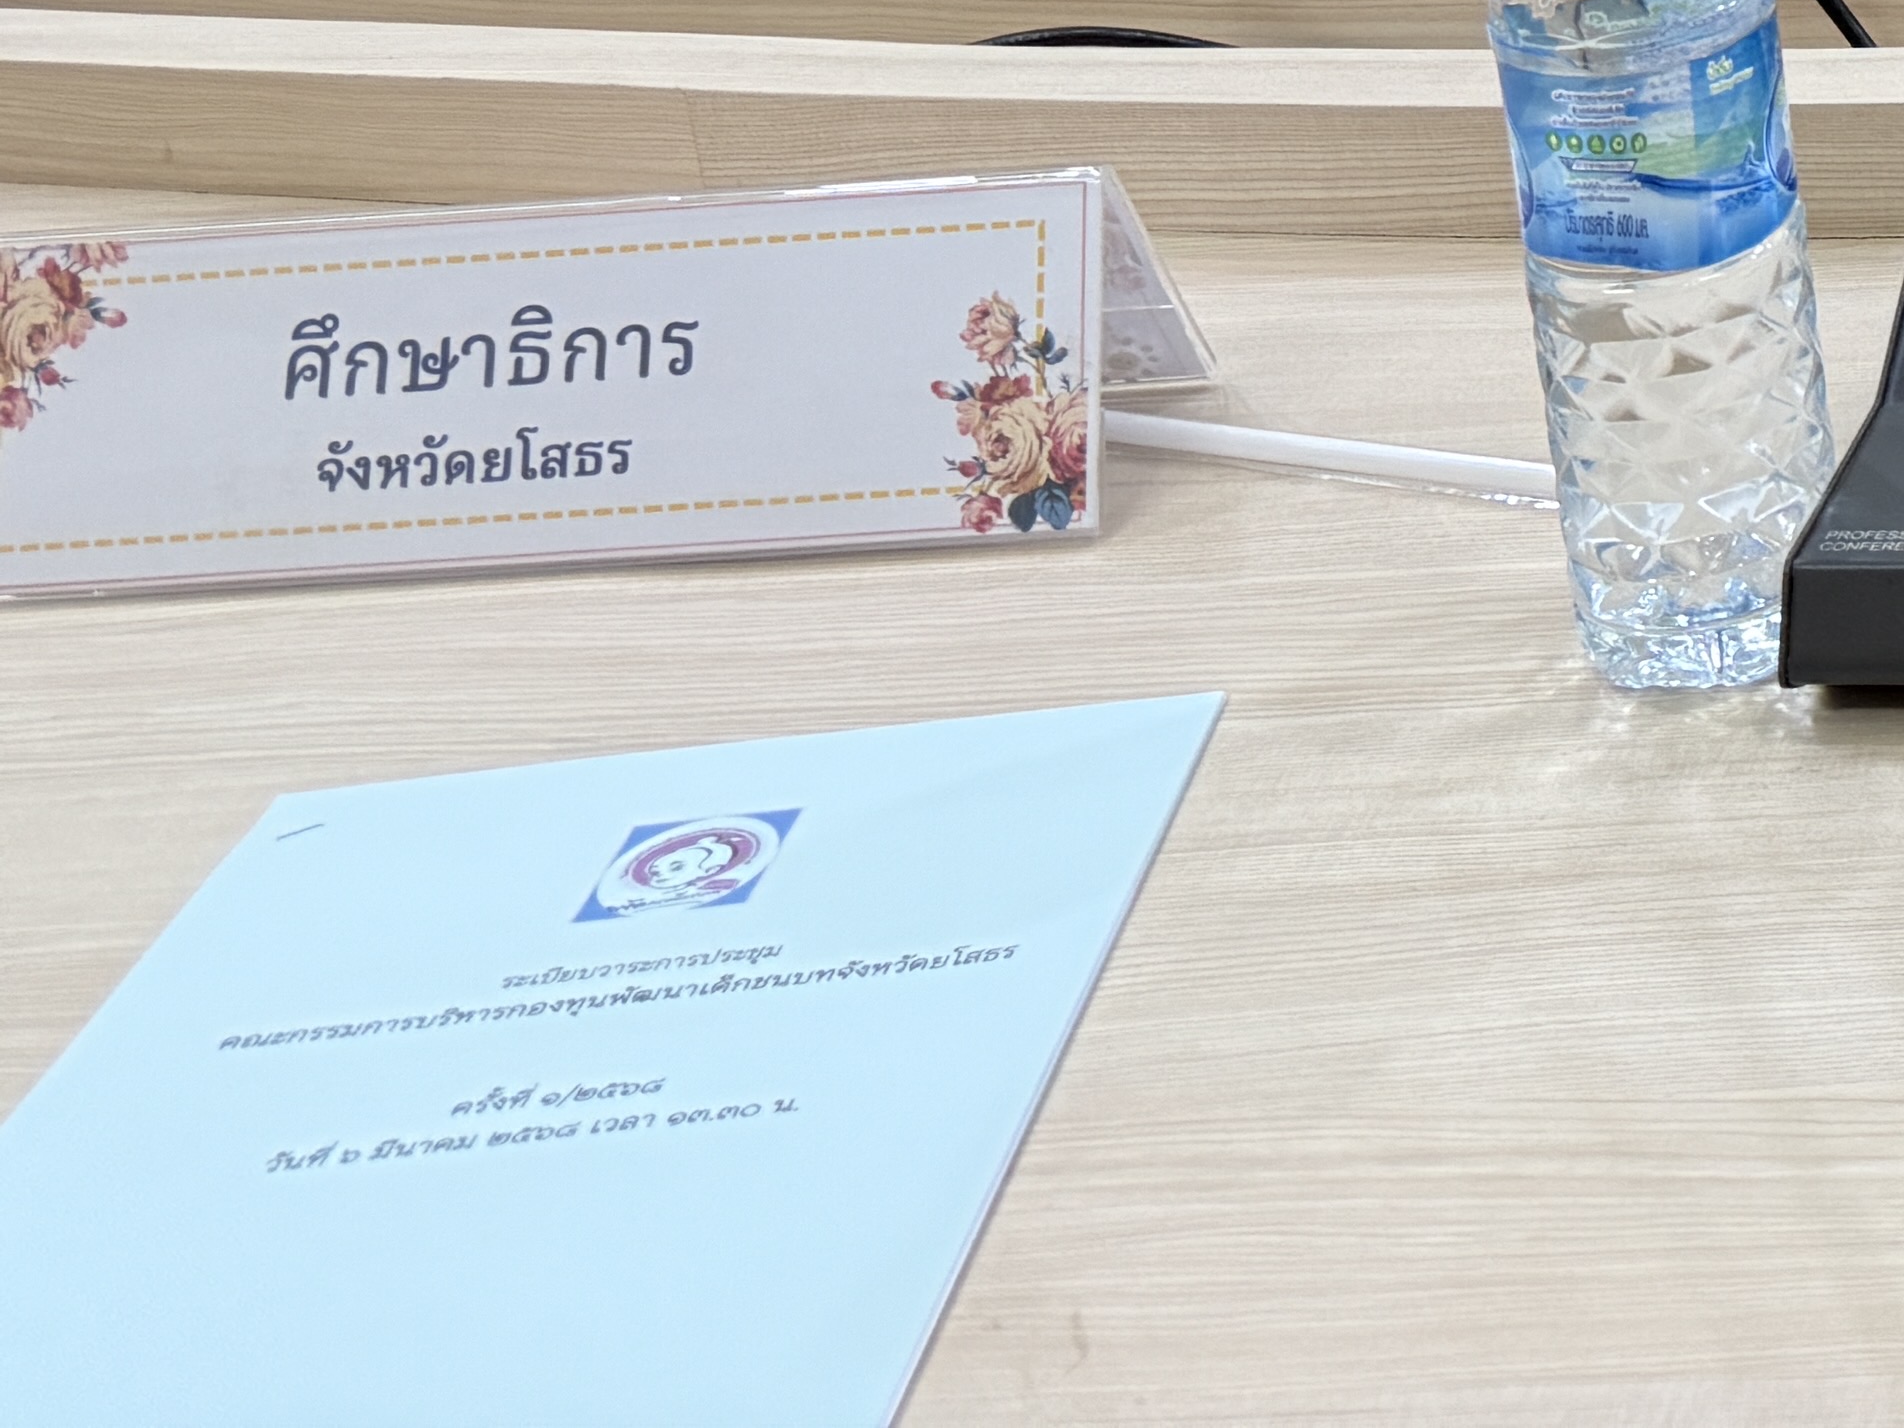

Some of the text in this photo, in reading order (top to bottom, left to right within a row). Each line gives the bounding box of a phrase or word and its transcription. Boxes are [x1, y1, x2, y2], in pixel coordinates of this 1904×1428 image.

[283, 304, 701, 401] ศึกษาธิการ
[315, 427, 635, 493] จังหวัดยโสธร
[218, 943, 1021, 1051] คณะกรรมการบริหารกองทุนพัฒนาเด็กชนบทจังหวัดยโสธร
[501, 945, 784, 990] ระเบียบวาระการประชุม
[450, 1076, 668, 1117] ครั้งที่ ๑/๒๕๖๘
[266, 1140, 340, 1173] วันที่
[367, 1134, 478, 1161] มีนาคม
[590, 1111, 656, 1135] เวลา
[773, 1097, 800, 1114] น.
